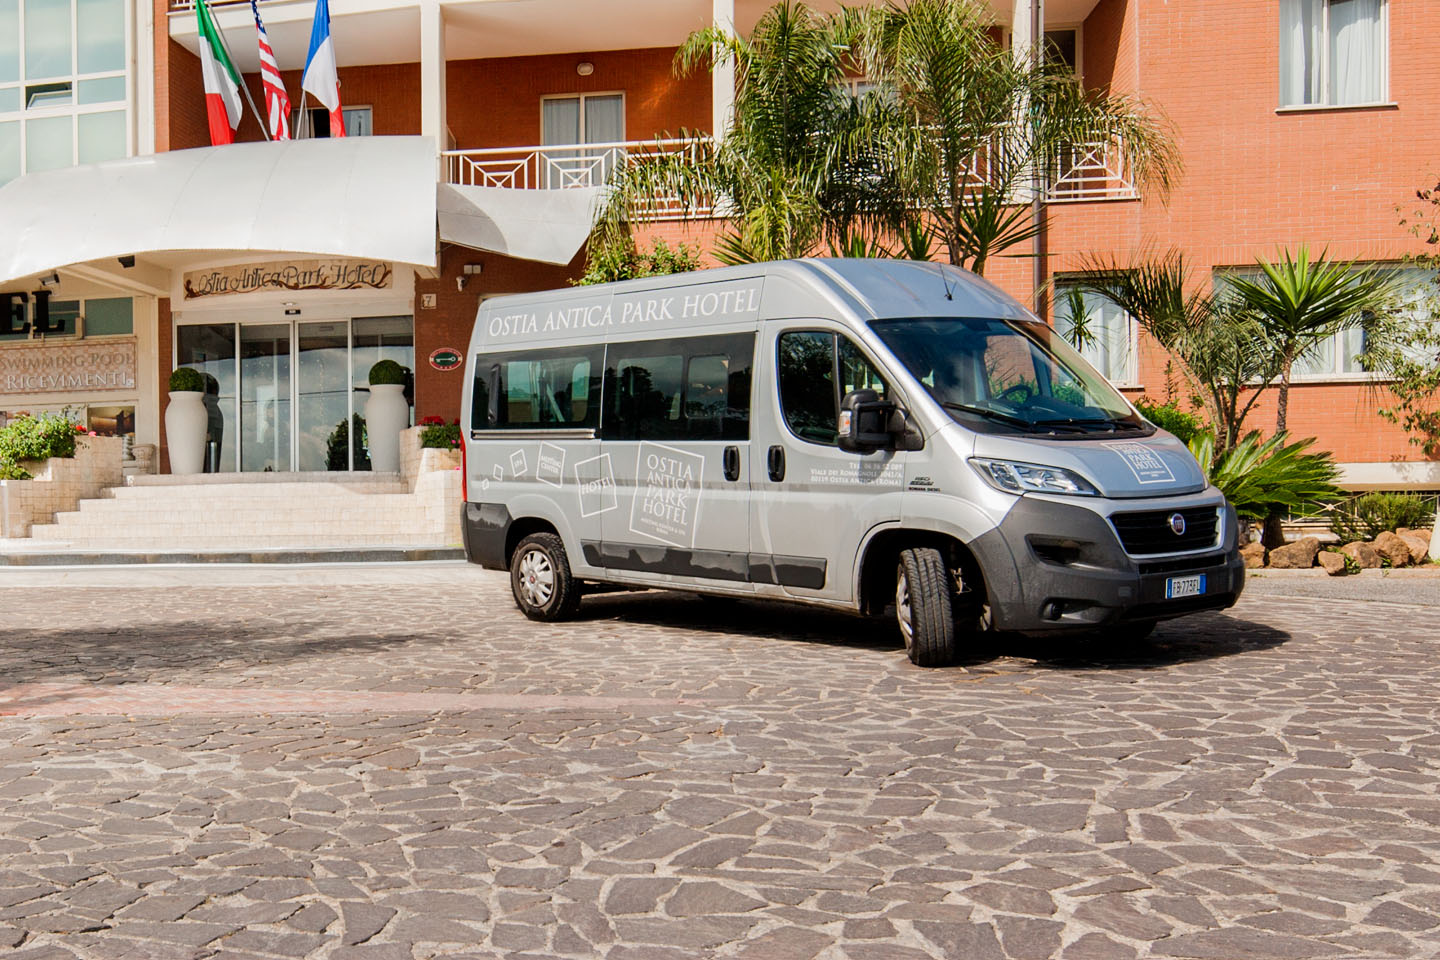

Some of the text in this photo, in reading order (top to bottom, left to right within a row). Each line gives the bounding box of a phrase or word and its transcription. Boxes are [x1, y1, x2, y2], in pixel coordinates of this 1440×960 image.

[489, 289, 759, 337] OSTIA ANTICA PARK HOTEL
[0, 352, 132, 371] SWIMMING POOL
[7, 371, 127, 390] RICEVIMENTI
[647, 454, 692, 481] OSTIA
[581, 476, 613, 495] HOTEL
[647, 470, 691, 495] ANTICA
[646, 484, 688, 509] PARK
[643, 498, 688, 526] HOTEL
